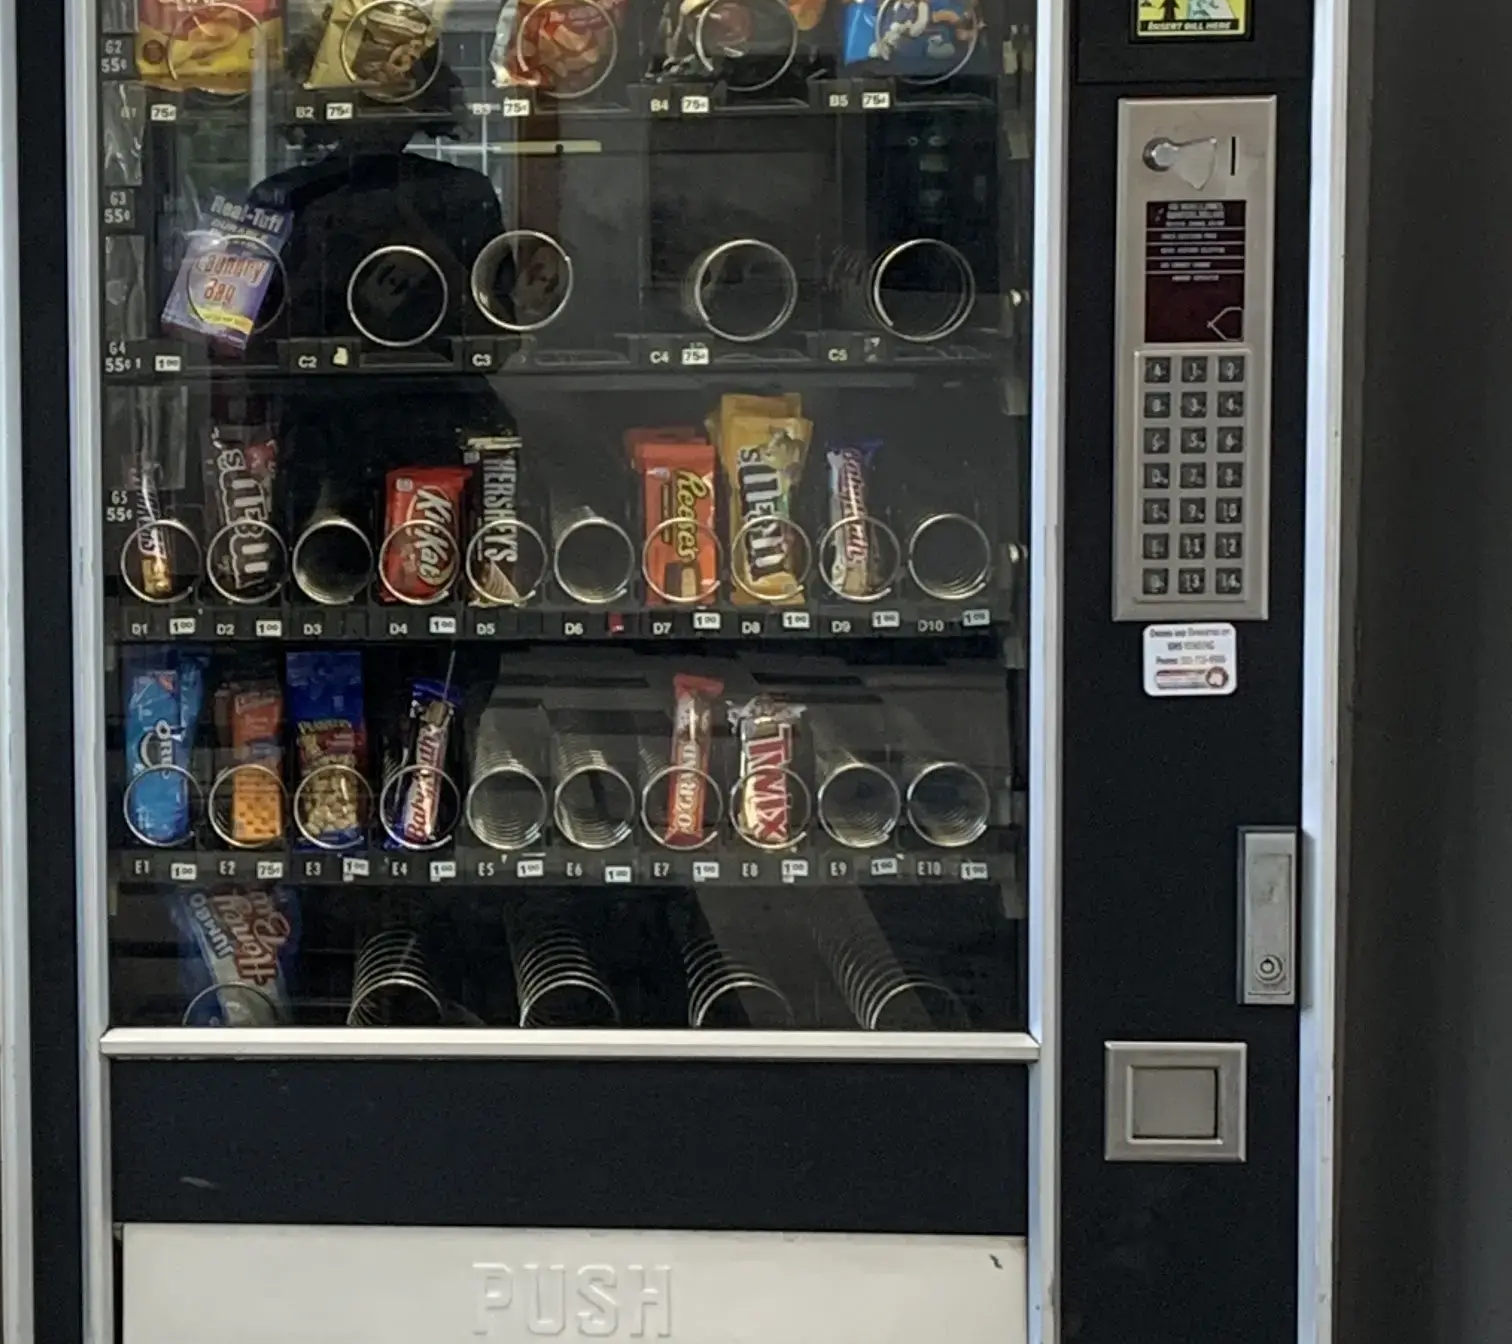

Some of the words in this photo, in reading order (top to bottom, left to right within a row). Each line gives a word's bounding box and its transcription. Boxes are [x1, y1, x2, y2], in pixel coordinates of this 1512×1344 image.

[105, 41, 122, 54] G2
[101, 59, 128, 73] 55¢
[505, 102, 528, 113] 75¢
[651, 99, 669, 111] B4
[829, 95, 848, 107] B5
[154, 107, 176, 119] 75¢
[296, 107, 314, 118] B2
[110, 192, 126, 205] G3
[104, 209, 130, 223] 55¢
[196, 255, 269, 288] Laundry
[203, 277, 237, 306] Bag
[109, 341, 126, 355] G4
[828, 349, 847, 361] C5
[298, 355, 317, 369] C2
[472, 354, 491, 367] C3
[650, 350, 670, 364] C4
[105, 358, 131, 372] 55¢
[111, 491, 128, 505] G5
[106, 507, 133, 522] 55¢
[483, 458, 518, 562] HERSHEY'S
[675, 469, 708, 562] Reese's
[739, 446, 788, 585] m&m's
[218, 449, 270, 589] m&m's
[132, 623, 148, 635] D1
[217, 624, 234, 635] D2
[304, 623, 322, 636] D3
[389, 623, 408, 635] D4
[477, 623, 495, 635] D5
[564, 621, 584, 635] D6
[653, 622, 672, 635] D7
[742, 622, 760, 634] D8
[832, 621, 851, 633] D9
[918, 620, 944, 632] D10
[746, 724, 792, 840] TWIX
[135, 860, 150, 874] E1
[220, 861, 236, 875] E2
[260, 864, 281, 876] 75¢
[306, 862, 321, 876] E3
[392, 862, 407, 876] E4
[479, 862, 494, 876] E5
[566, 862, 583, 877] E6
[654, 863, 670, 877] E7
[742, 863, 758, 877] E8
[830, 862, 847, 876] E9
[917, 861, 941, 876] E10
[472, 1262, 671, 1338] PUSH
